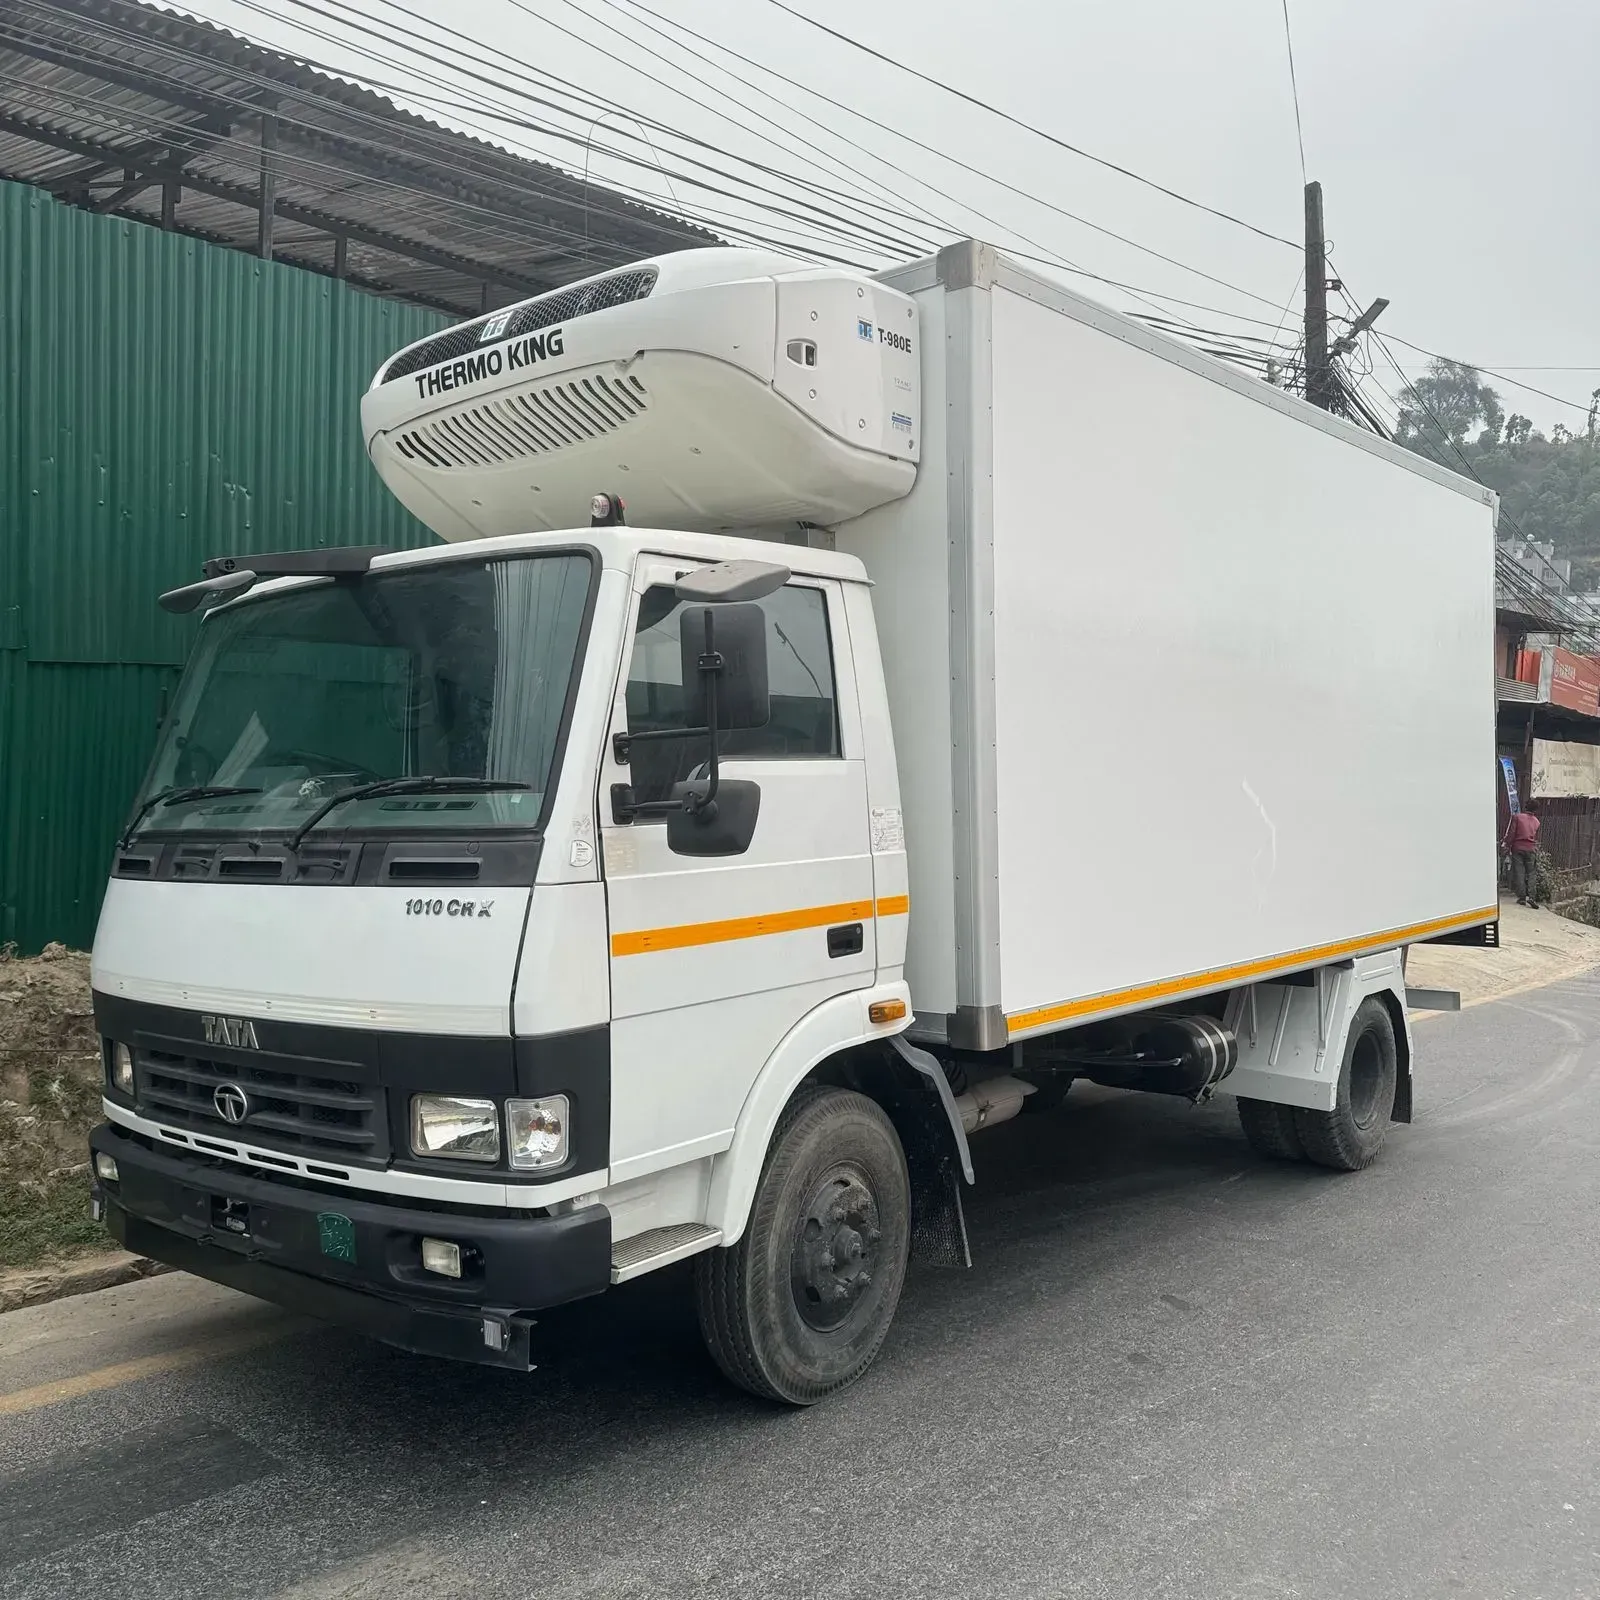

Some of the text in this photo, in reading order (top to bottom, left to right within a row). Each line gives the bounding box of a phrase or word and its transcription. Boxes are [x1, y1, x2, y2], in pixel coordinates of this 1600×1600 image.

[877, 327, 912, 354] T-980E
[415, 328, 565, 399] THERMO KING
[406, 899, 443, 916] 1010
[201, 1015, 260, 1050] TATA
